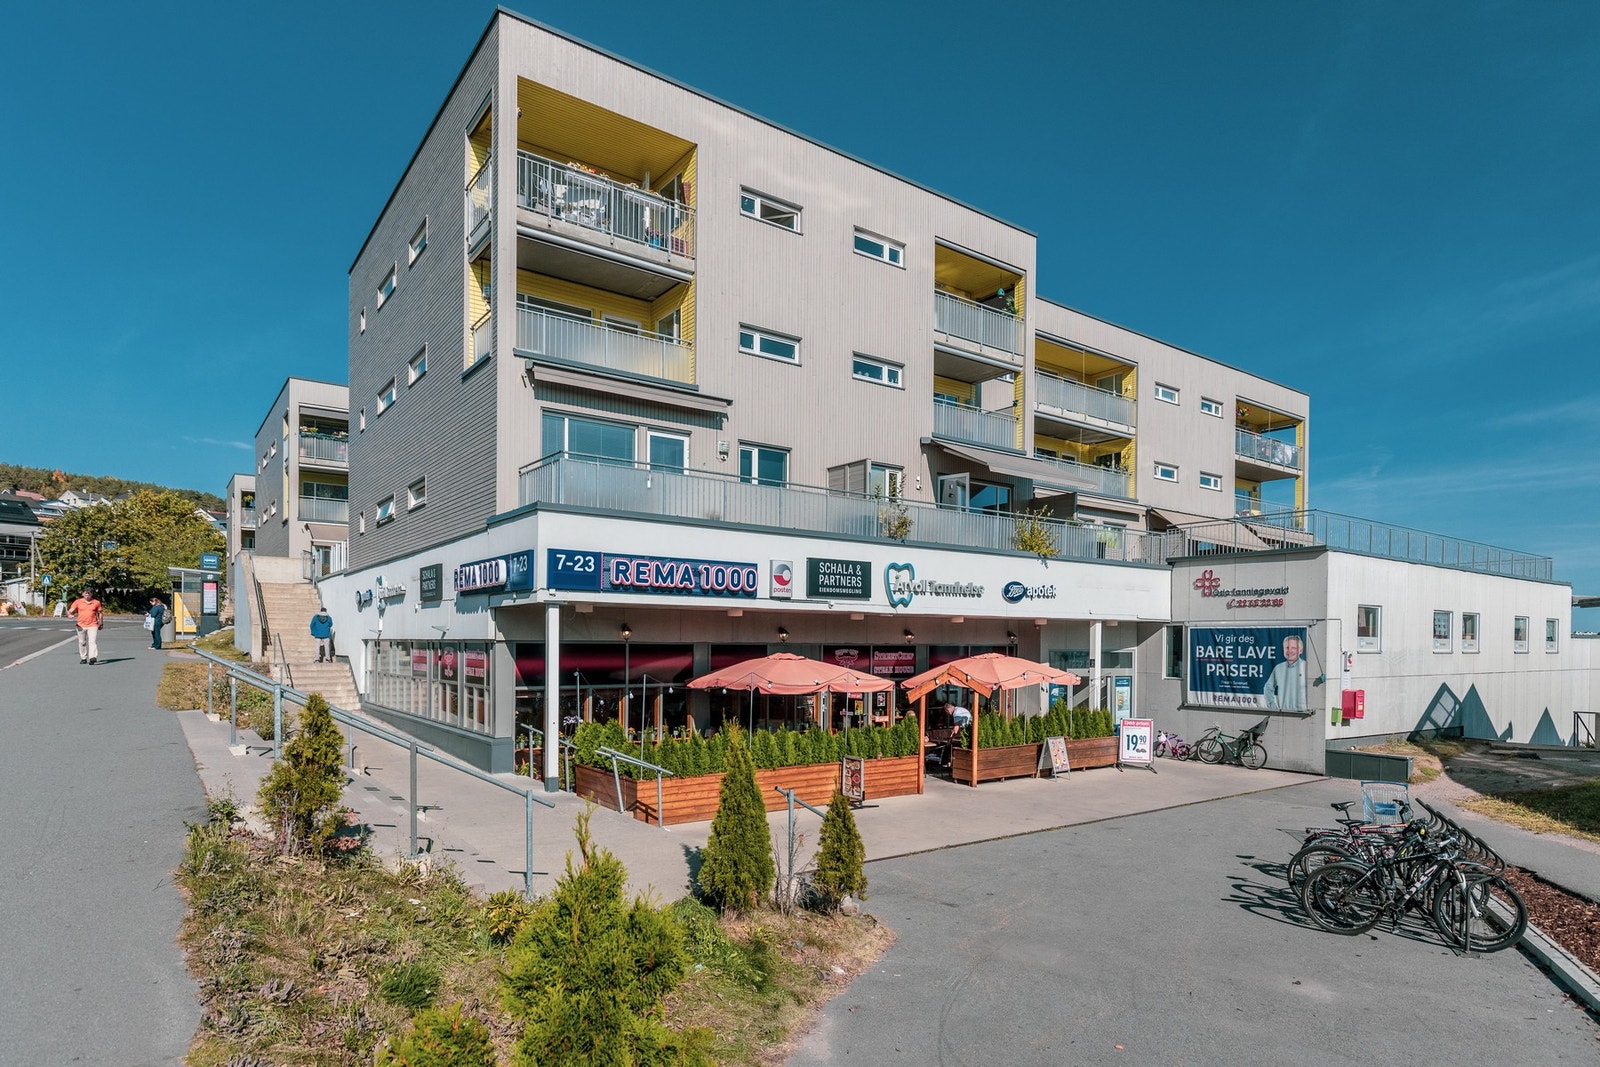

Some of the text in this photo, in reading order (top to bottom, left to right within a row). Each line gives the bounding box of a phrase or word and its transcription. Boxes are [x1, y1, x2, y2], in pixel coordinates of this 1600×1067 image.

[513, 555, 528, 573] 7-23
[556, 554, 595, 572] 7-23
[819, 562, 862, 575] SCHALA &
[454, 559, 501, 591] REMA 1000
[611, 558, 758, 592] REMA 1000
[819, 575, 862, 587] PARTNERS
[927, 580, 985, 594] Tannhelse
[1026, 585, 1057, 600] apotek
[1215, 634, 1255, 645] Vi gir deg
[1196, 645, 1276, 659] BARE LAVE
[1206, 664, 1264, 678] PRISER!
[1126, 734, 1147, 751] 19 90
